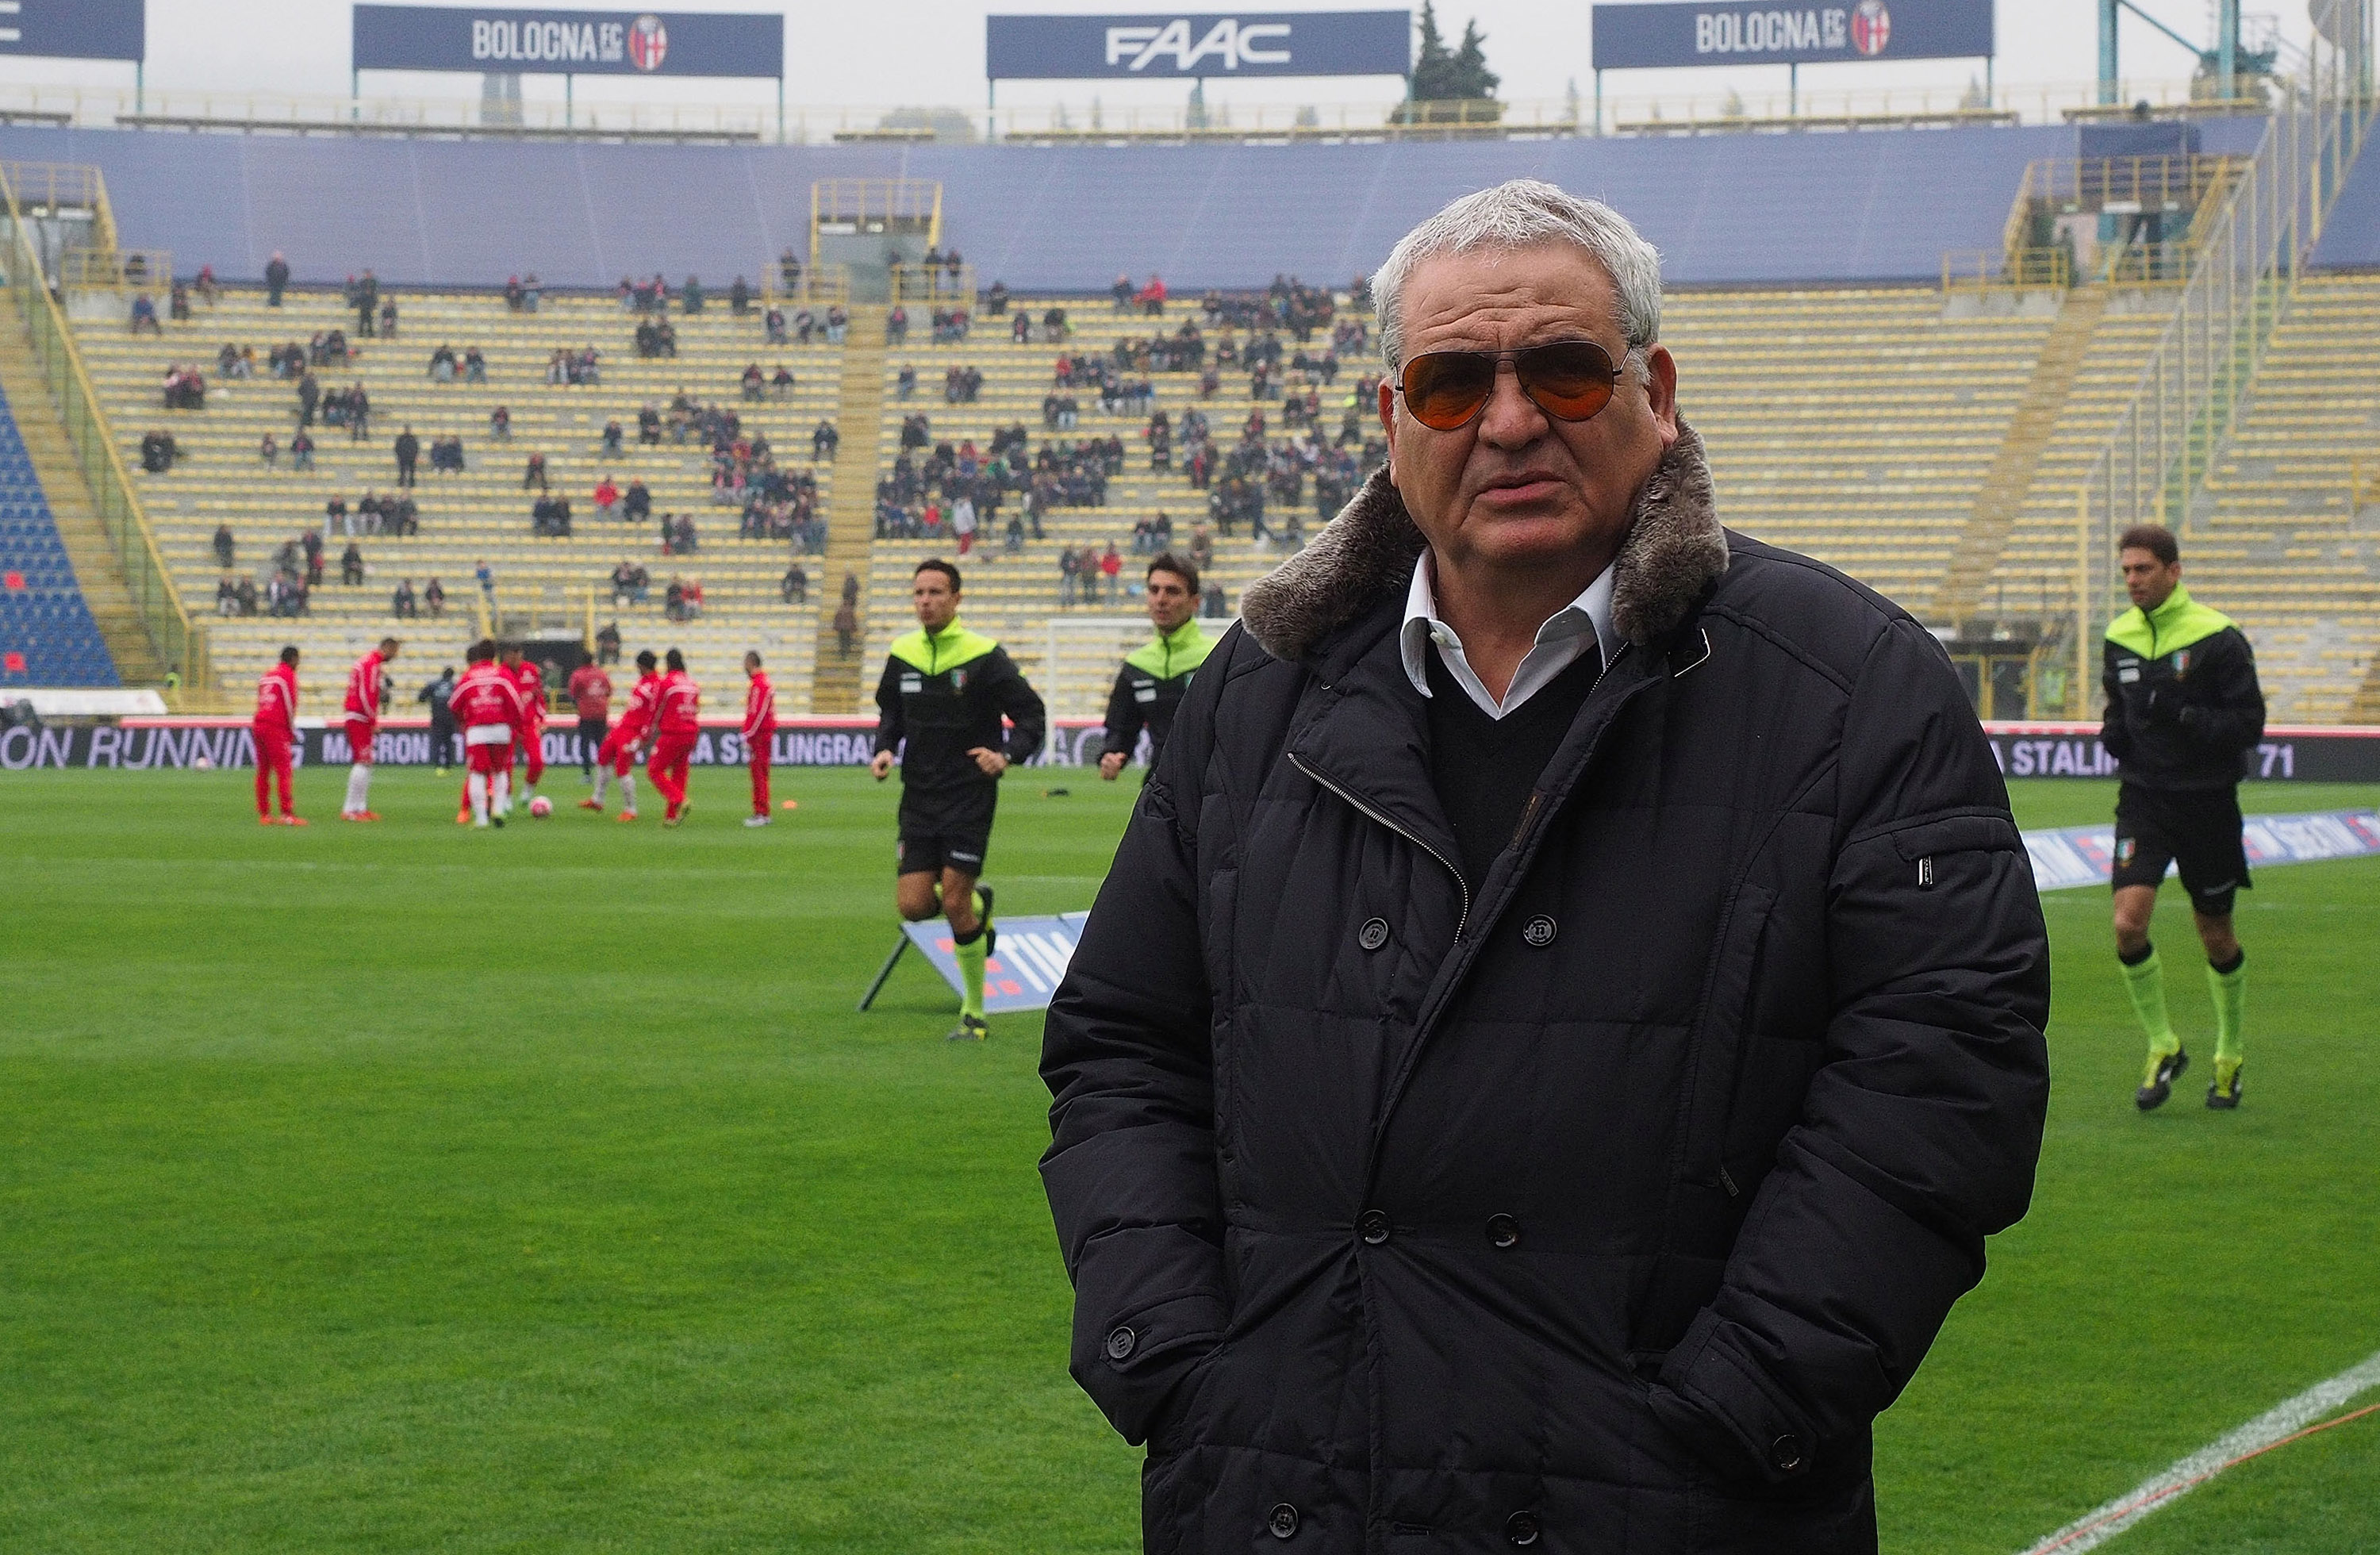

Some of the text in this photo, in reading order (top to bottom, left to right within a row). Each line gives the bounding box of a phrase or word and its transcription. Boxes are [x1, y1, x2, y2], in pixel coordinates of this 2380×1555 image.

[473, 20, 598, 62] BOLOGNA
[1105, 18, 1292, 71] FAAC
[1695, 10, 1821, 53] BOLOGNA
[322, 732, 431, 764] MRON
[2256, 743, 2294, 778] 71
